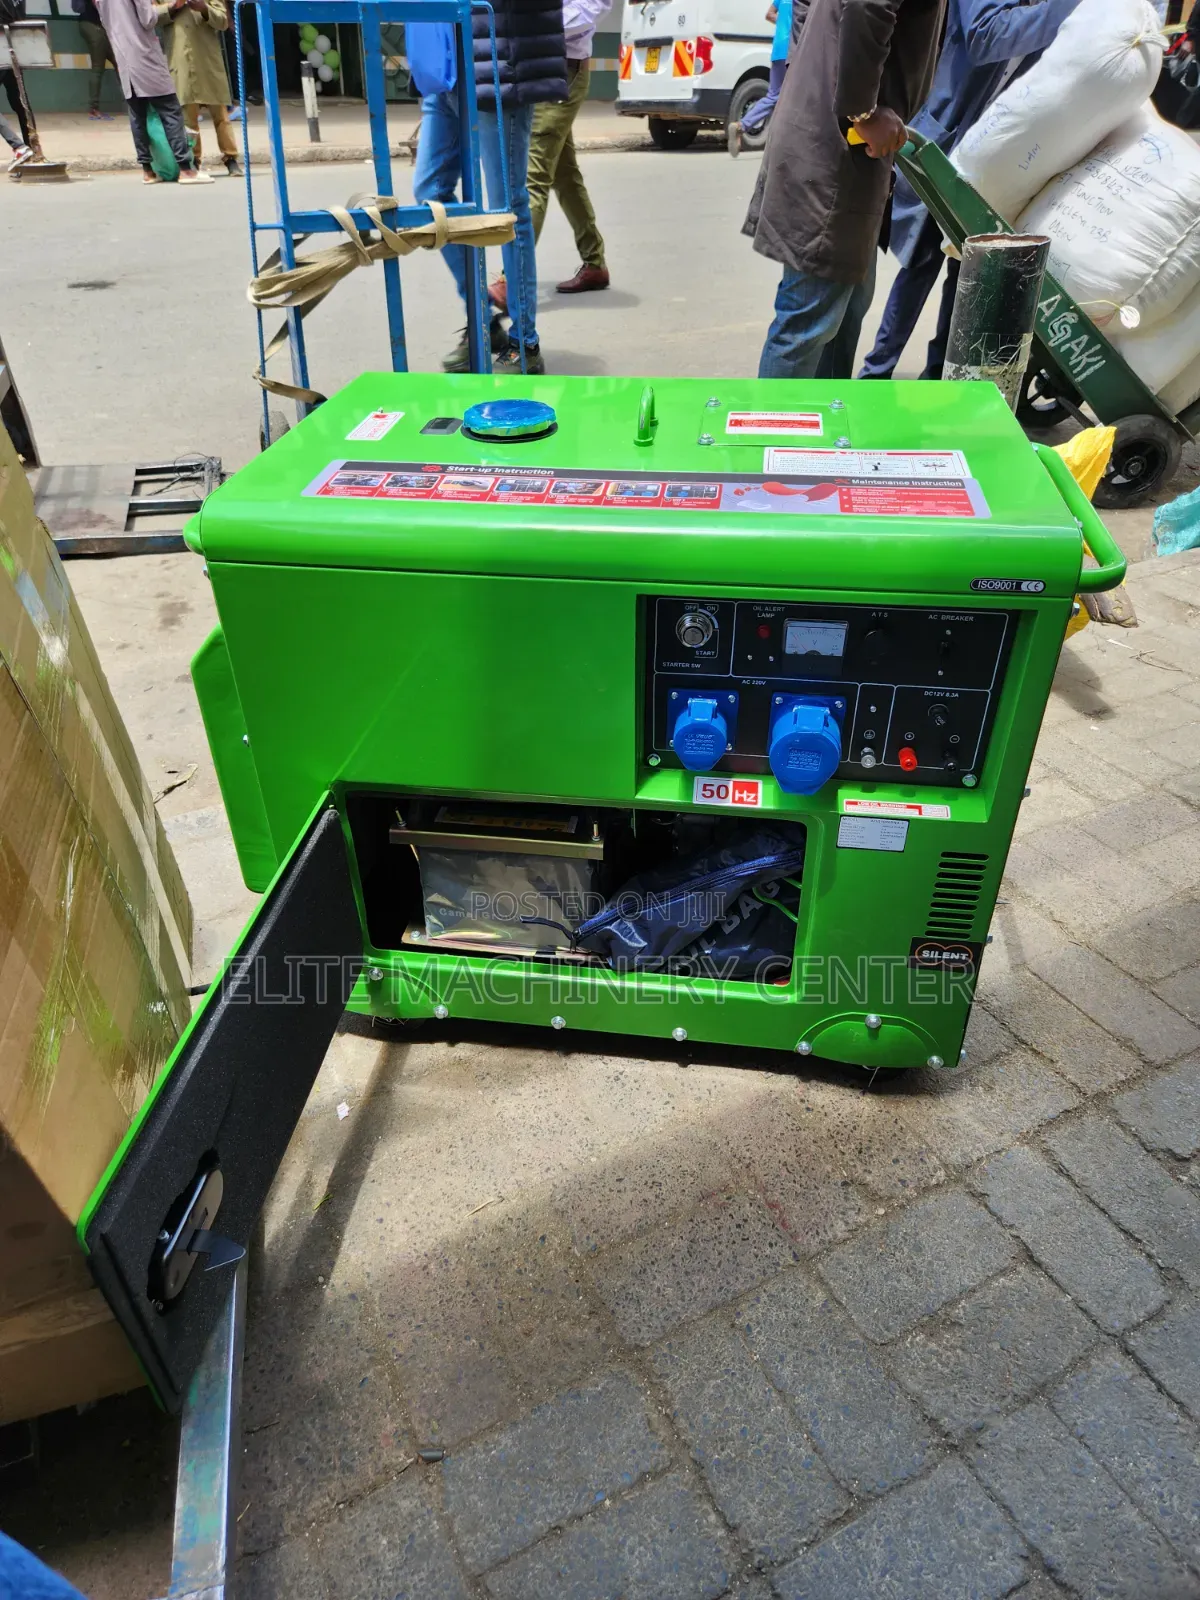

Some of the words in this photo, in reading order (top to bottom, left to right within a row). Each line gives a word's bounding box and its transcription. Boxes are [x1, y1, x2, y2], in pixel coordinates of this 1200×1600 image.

[447, 465, 492, 473] Start-up
[494, 467, 555, 475] Instruction
[977, 580, 1018, 591] ISO9001
[701, 783, 730, 800] 50
[734, 789, 757, 803] Hz
[720, 881, 780, 934] BAG
[922, 949, 969, 961] SILENT
